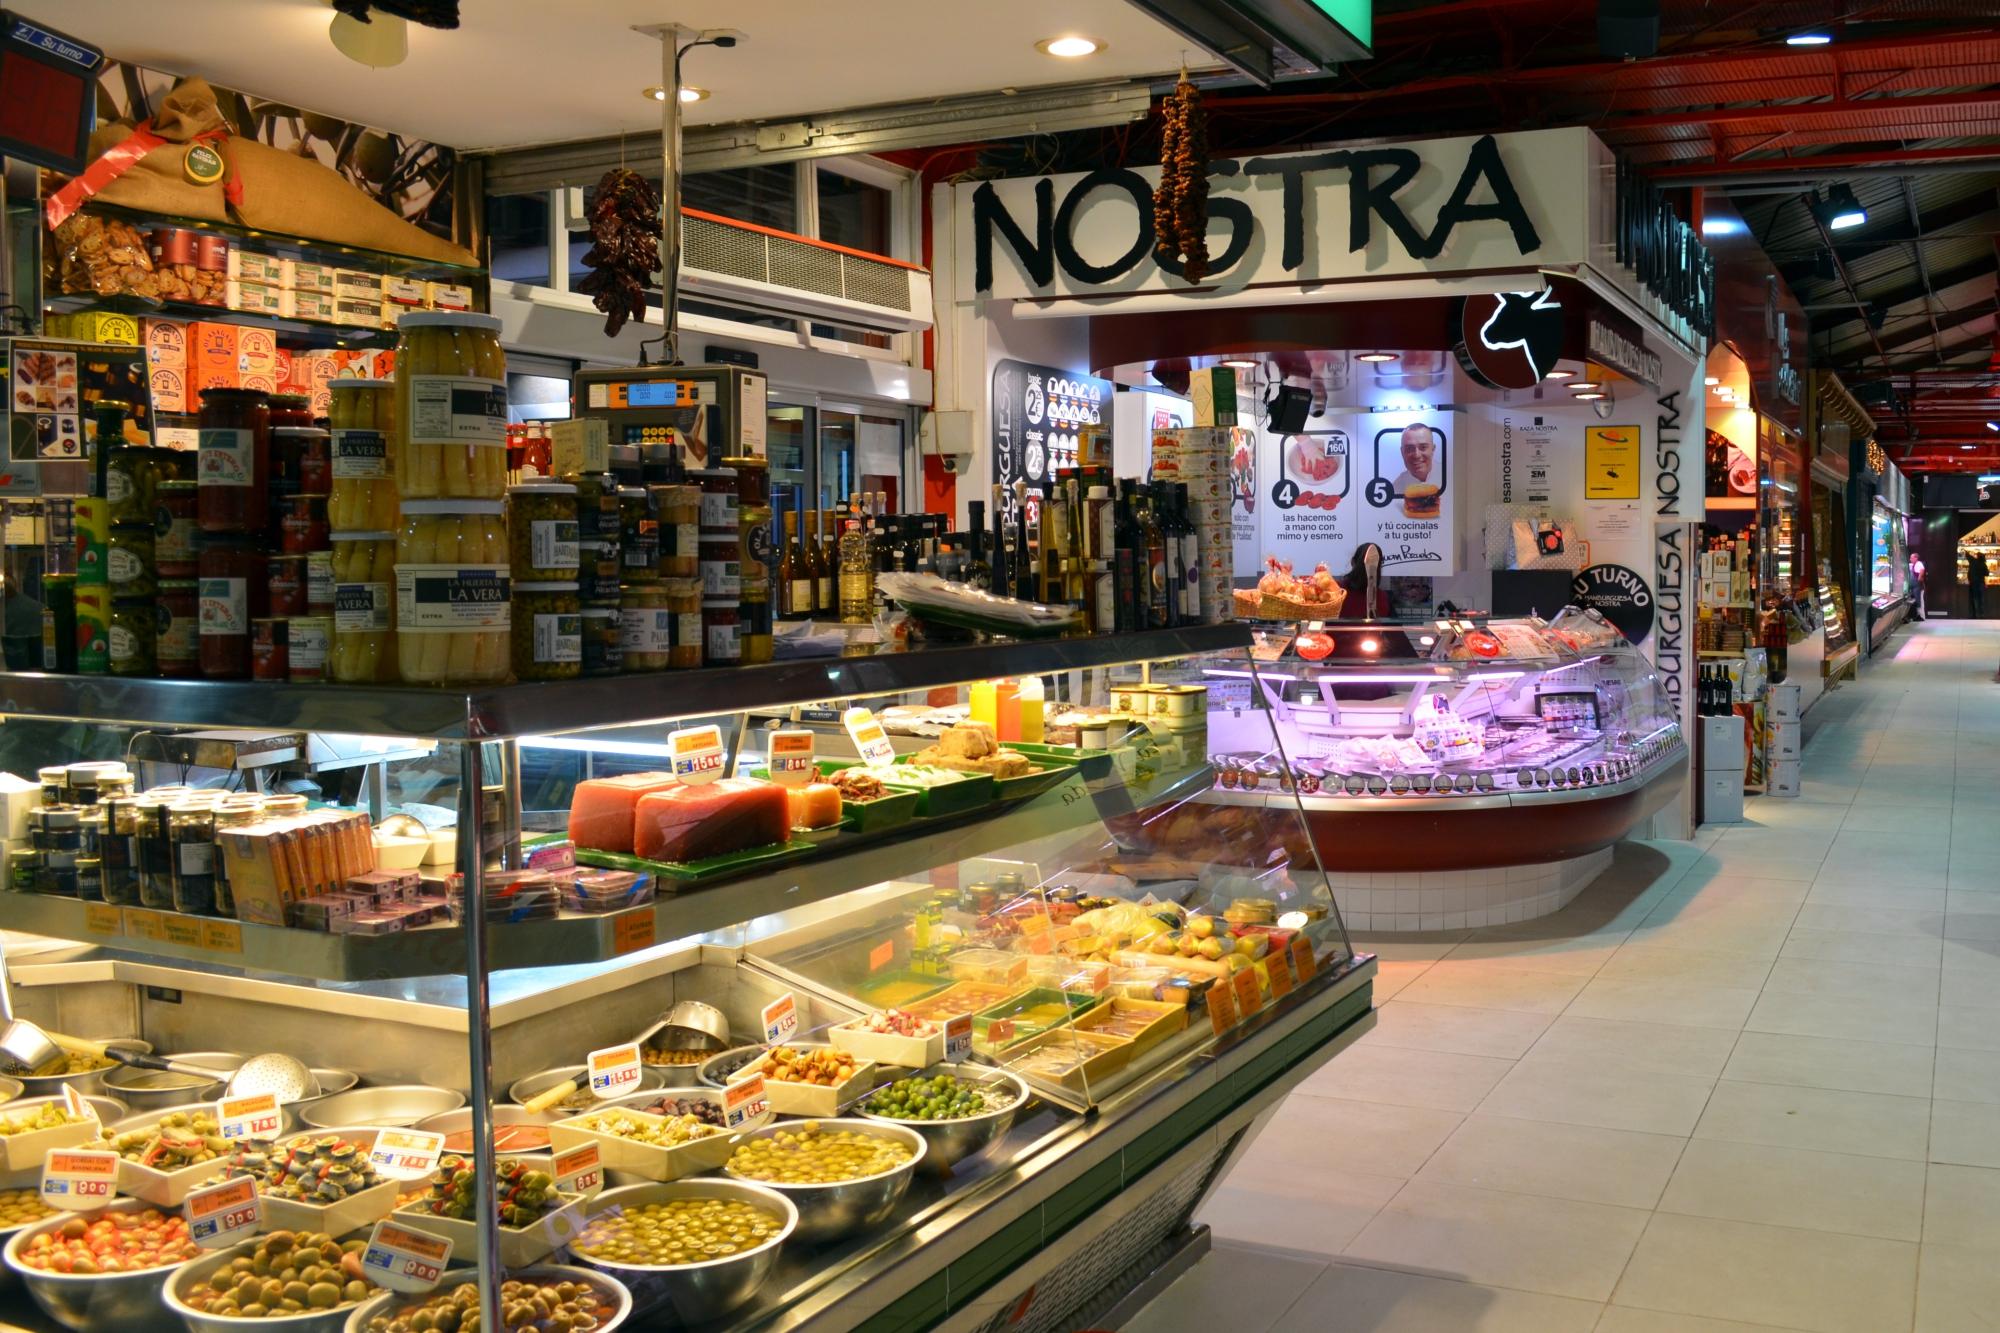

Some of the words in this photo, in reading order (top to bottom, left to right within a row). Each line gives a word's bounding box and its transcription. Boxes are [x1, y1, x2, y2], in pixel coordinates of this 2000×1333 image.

[41, 37, 57, 50] Su
[57, 43, 84, 61] turno
[341, 446, 354, 455] LA
[357, 446, 384, 456] VERA
[1328, 444, 1344, 453] 160
[1656, 390, 1681, 516] NOSTRA
[1278, 484, 1293, 505] 4
[1373, 483, 1387, 503] 5
[1283, 513, 1295, 522] las
[1297, 513, 1337, 522] hacemos
[1277, 532, 1302, 540] mimo
[1392, 532, 1401, 540] tu
[1403, 531, 1432, 541] gusto!
[448, 589, 467, 601] LA
[472, 589, 502, 601] VERA
[1590, 567, 1649, 607] TURNO
[79, 1180, 106, 1194] 900
[226, 1209, 254, 1227] 900
[405, 1260, 437, 1279] 900
